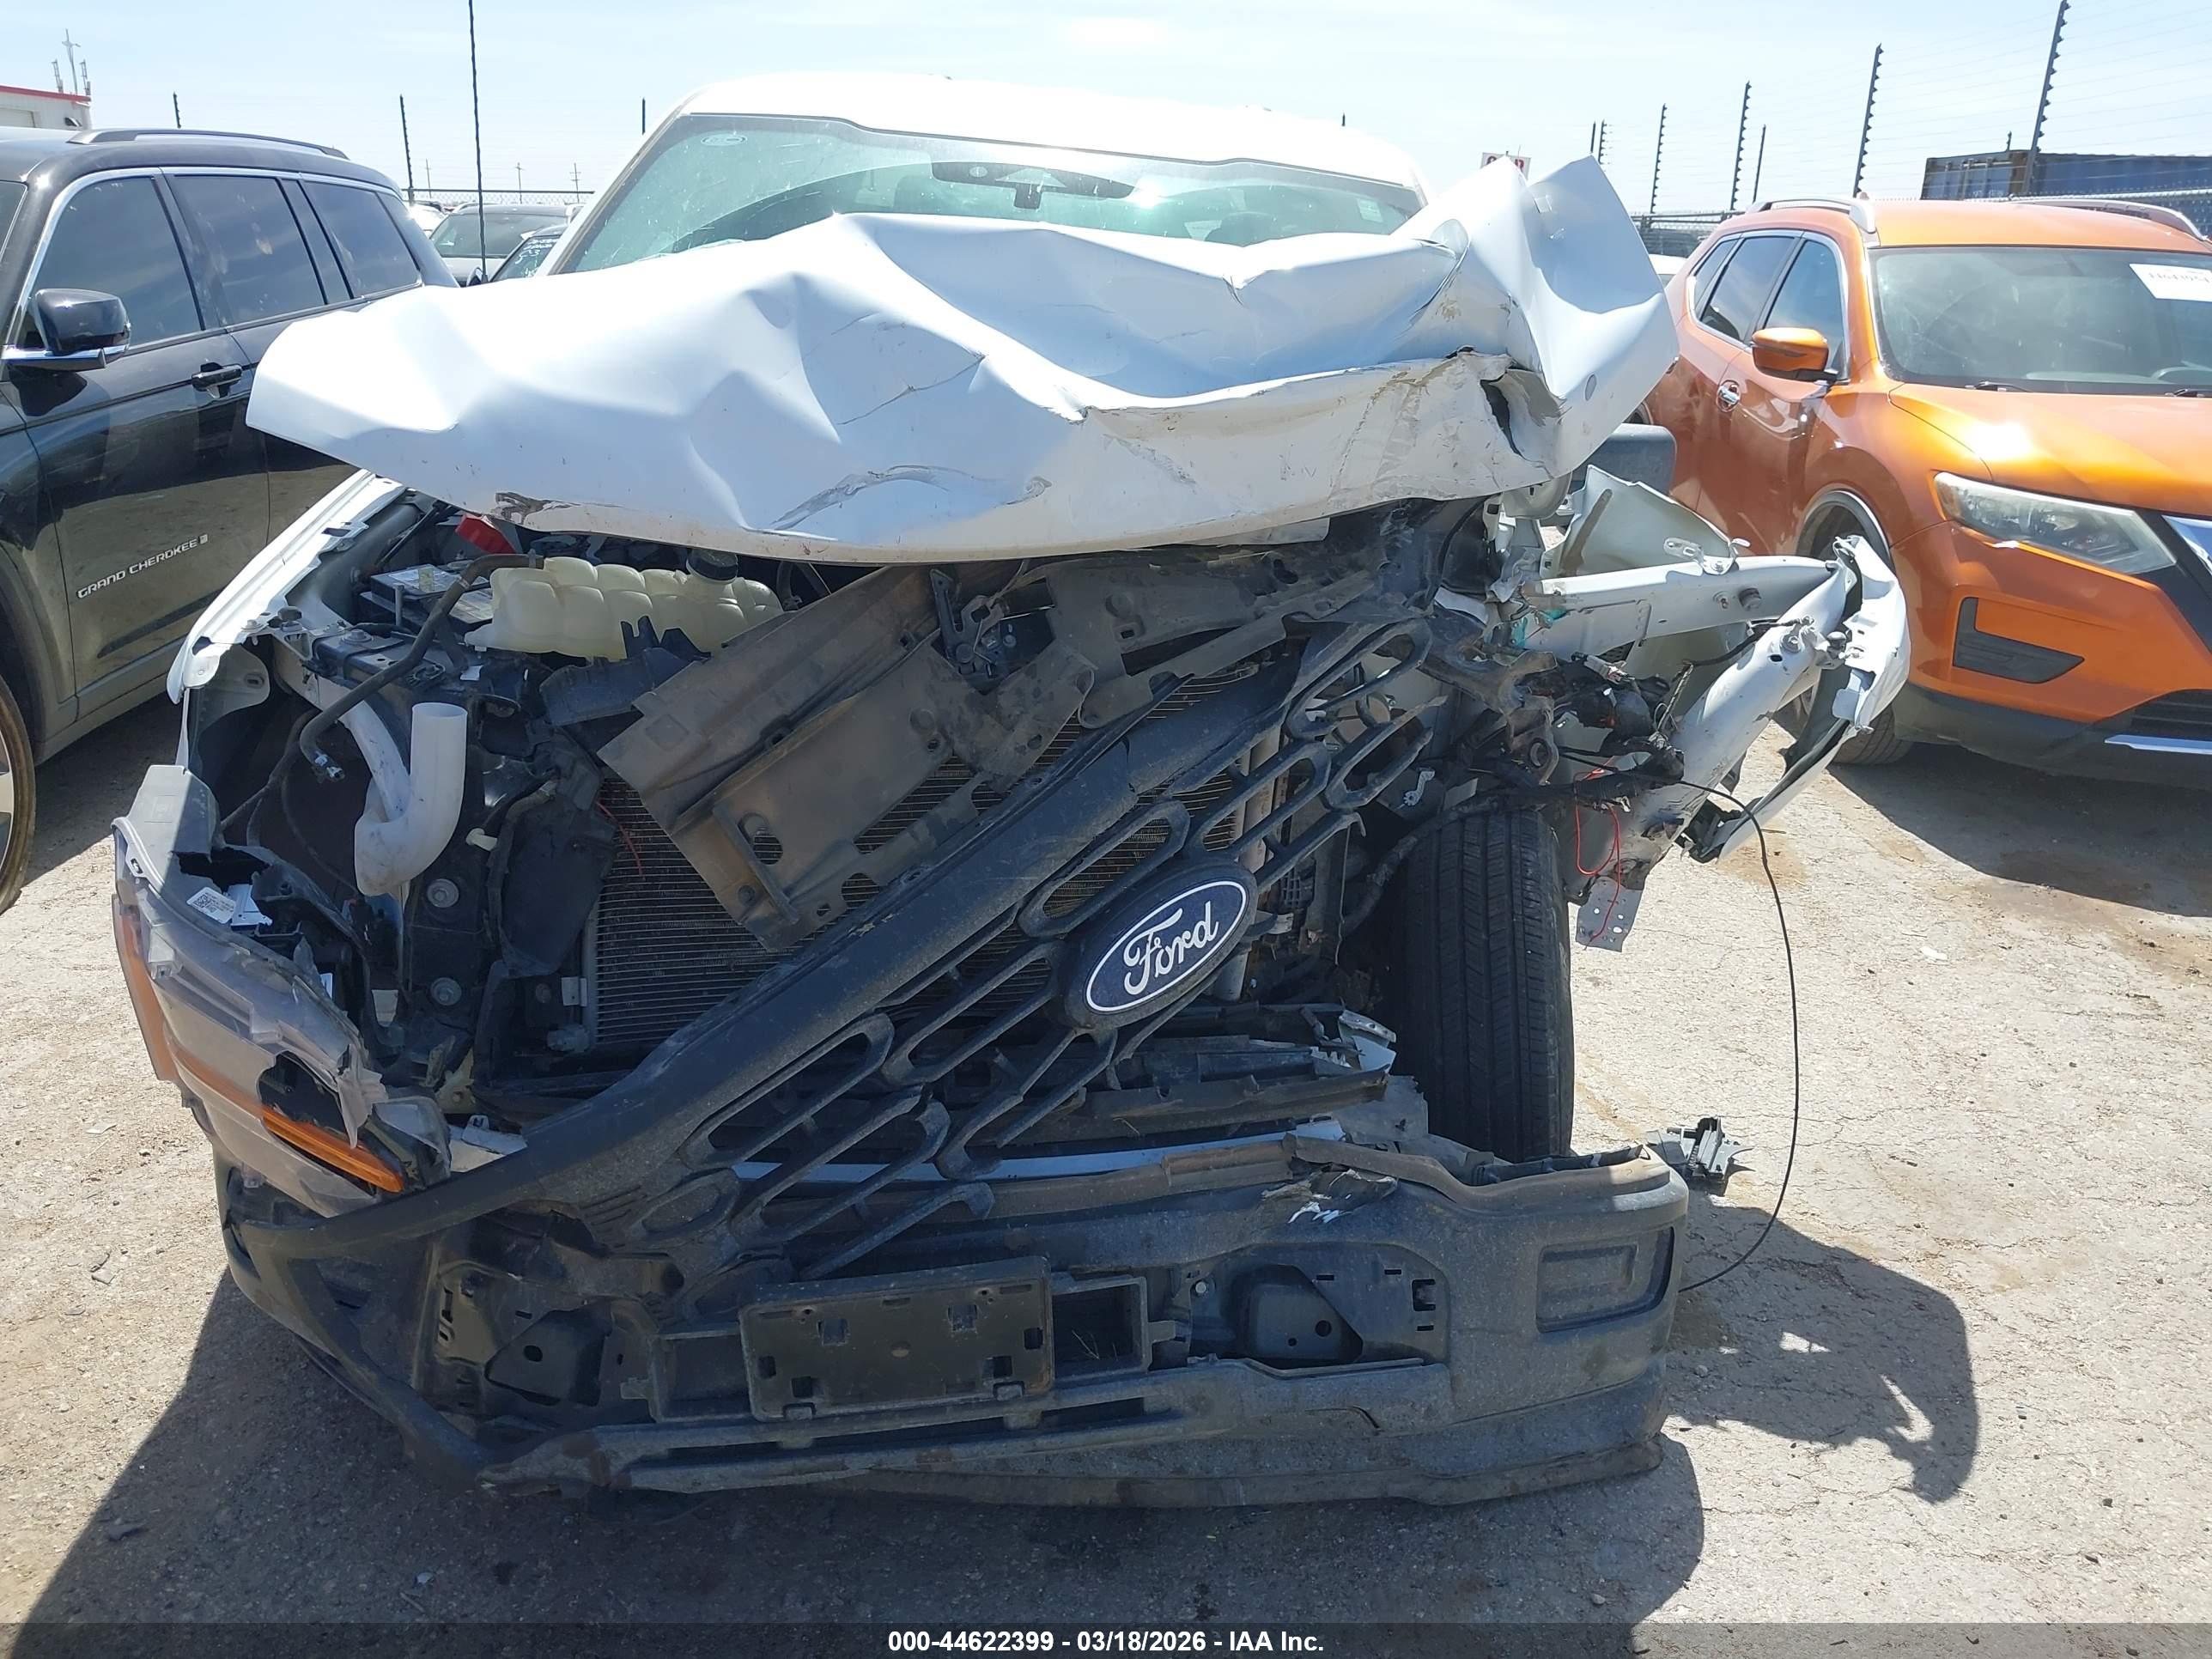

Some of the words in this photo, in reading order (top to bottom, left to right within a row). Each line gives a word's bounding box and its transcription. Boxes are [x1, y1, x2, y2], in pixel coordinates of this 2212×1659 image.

[77, 570, 126, 599] GRAND
[129, 538, 198, 574] CHEROKEE
[1123, 901, 1219, 995] Ford
